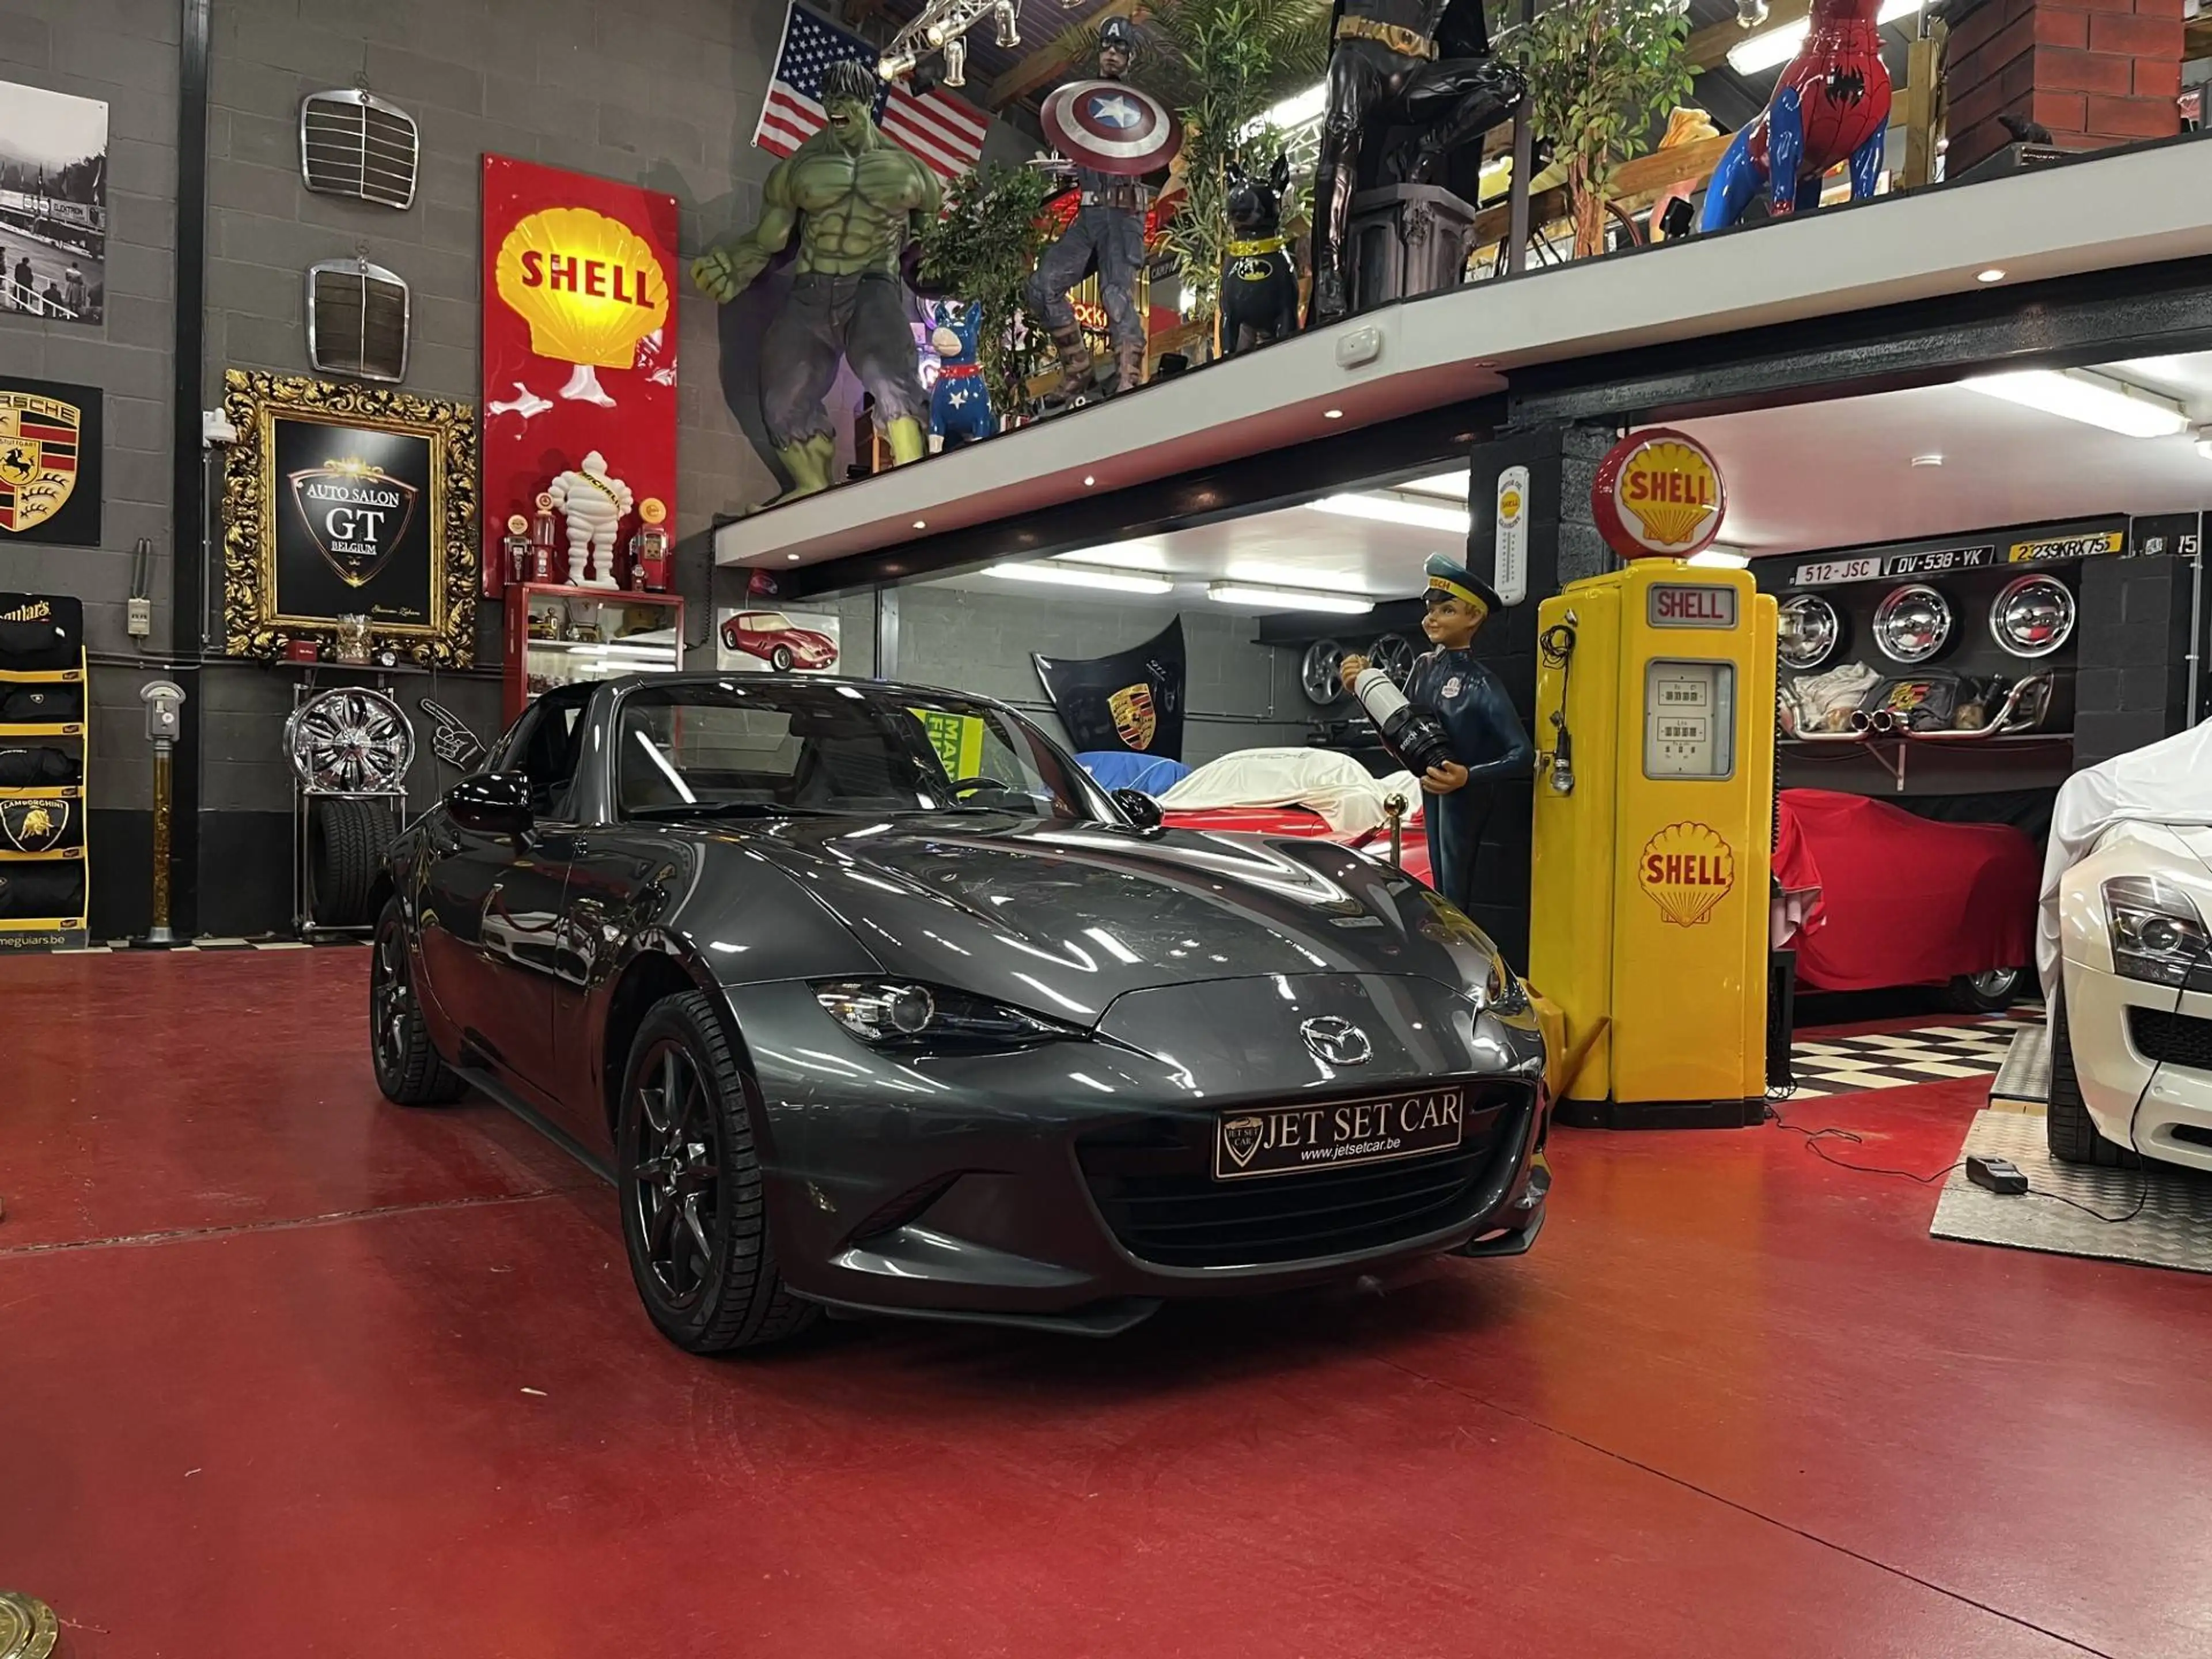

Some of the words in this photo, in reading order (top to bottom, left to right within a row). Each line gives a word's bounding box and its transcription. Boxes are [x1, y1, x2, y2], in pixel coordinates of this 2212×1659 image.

[1107, 22, 1120, 36] A
[521, 250, 655, 310] SHELL
[306, 484, 349, 499] AUTO
[352, 488, 399, 506] SALON
[1629, 471, 1712, 505] SHELL
[325, 507, 385, 542] GT
[332, 541, 376, 554] BELGIUM
[1805, 561, 1870, 582] 512-JSC
[1897, 549, 1982, 573] DV-538-YK
[1657, 591, 1724, 619] SHELL
[4, 800, 63, 809] LAMBORGHINI
[1646, 854, 1726, 885] SHELL
[1263, 1111, 1324, 1149] JET
[1334, 1103, 1392, 1142] SET
[1400, 1094, 1459, 1132] CAR
[1301, 1137, 1401, 1162] www.jetsetcar.be
